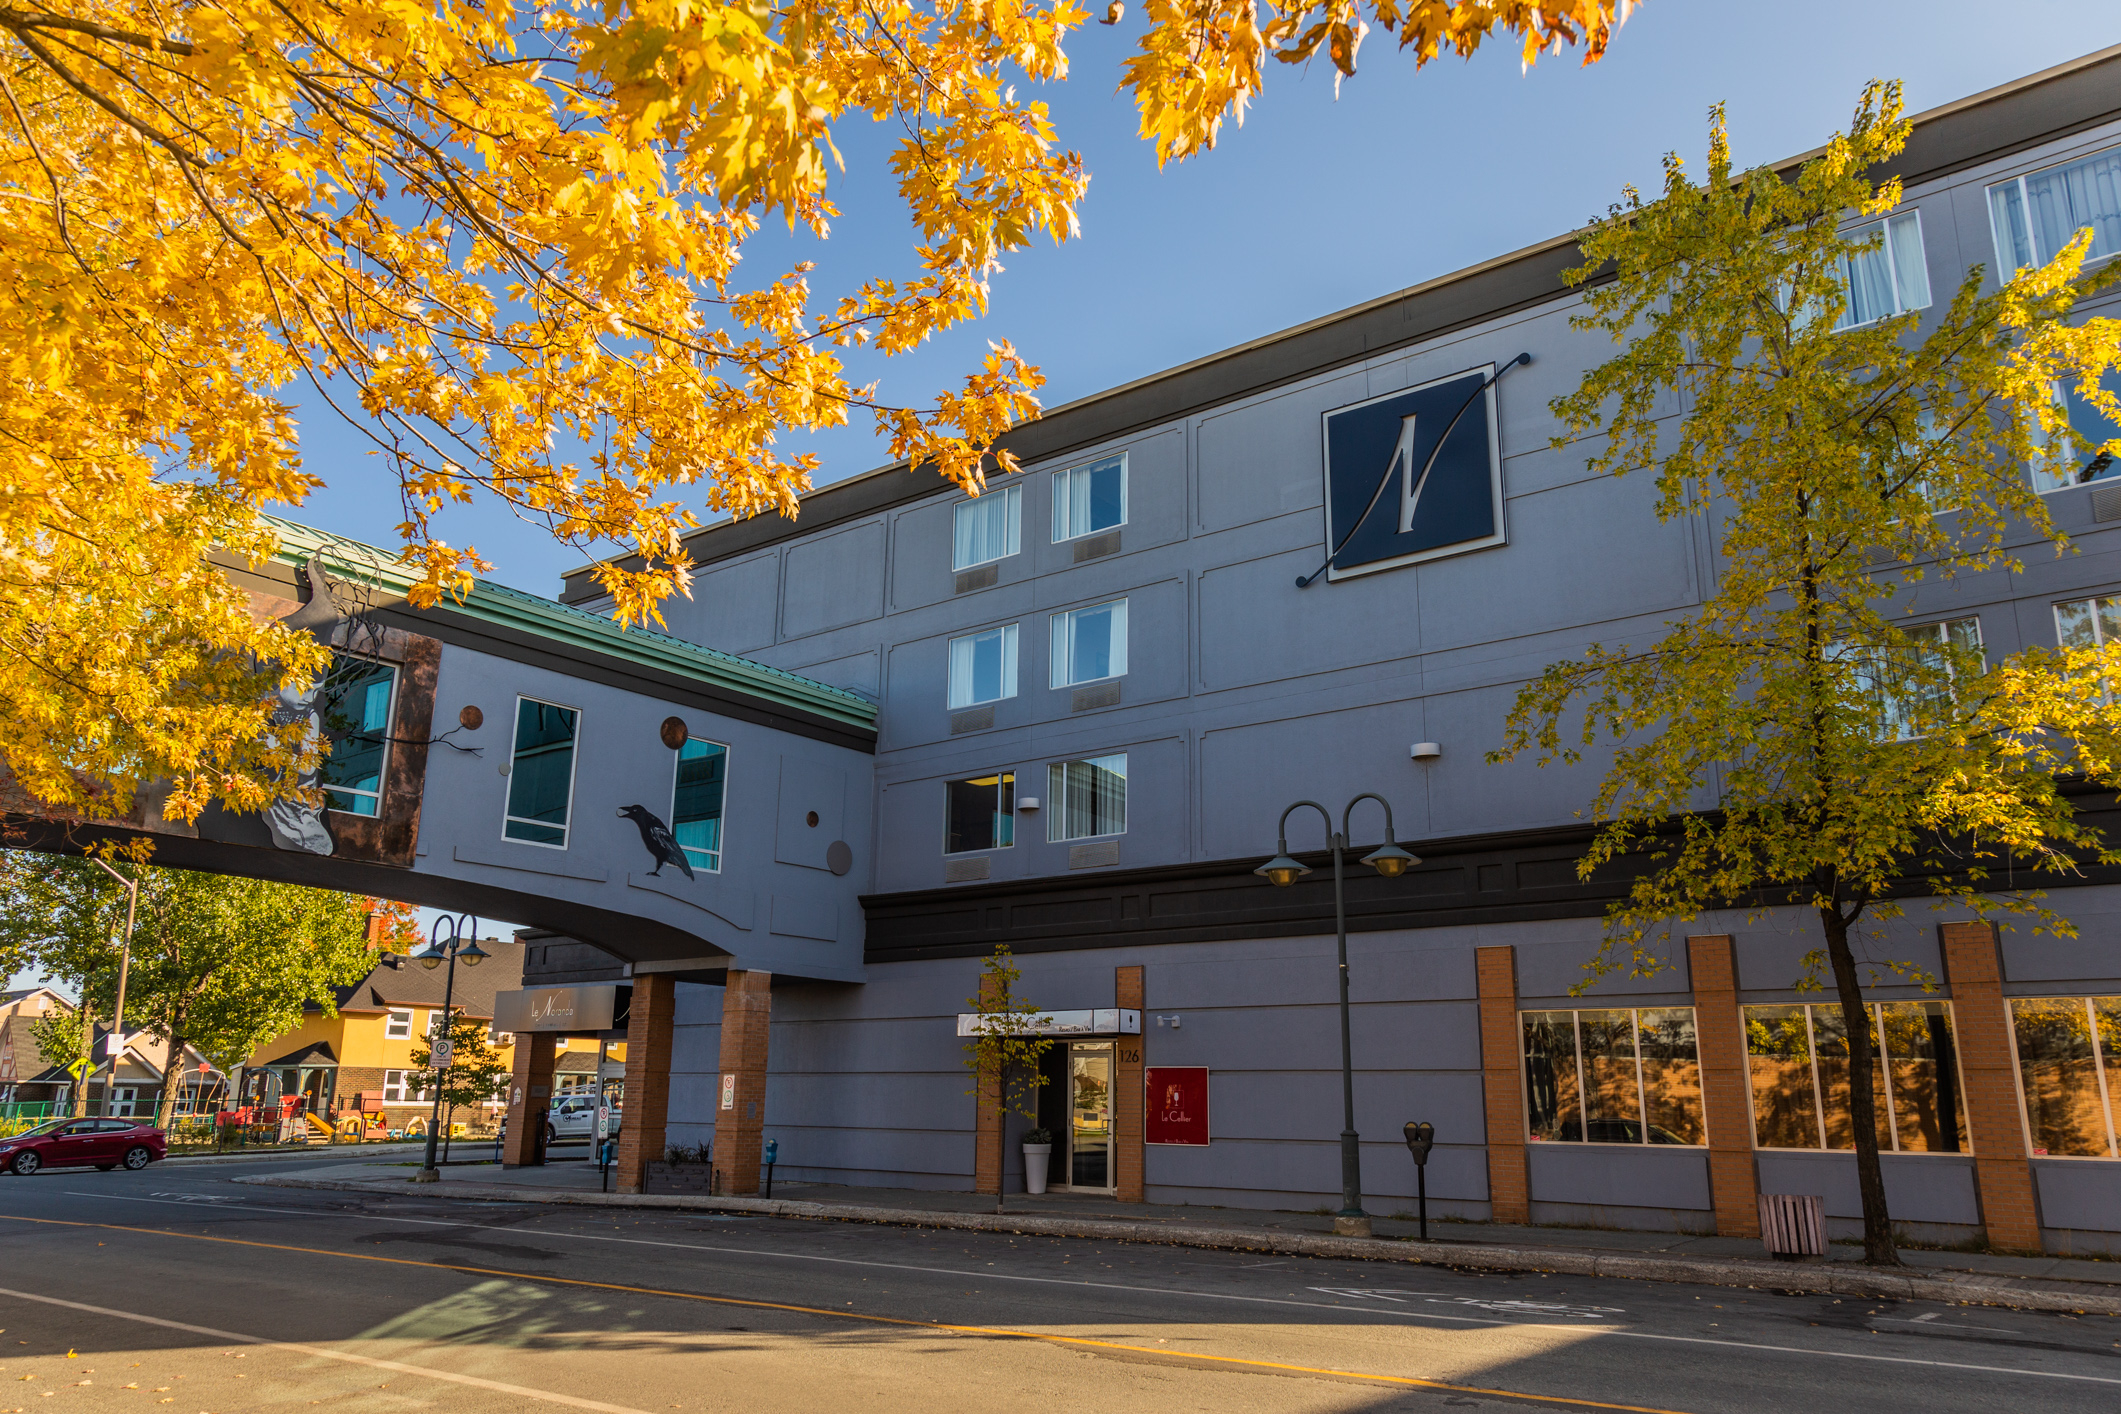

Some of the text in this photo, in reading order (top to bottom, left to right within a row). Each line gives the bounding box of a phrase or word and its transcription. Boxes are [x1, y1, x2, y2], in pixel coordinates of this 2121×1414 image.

[531, 990, 574, 1021] Le Noranda
[1119, 1049, 1139, 1063] 126
[1161, 1110, 1192, 1122] Le Cellier
